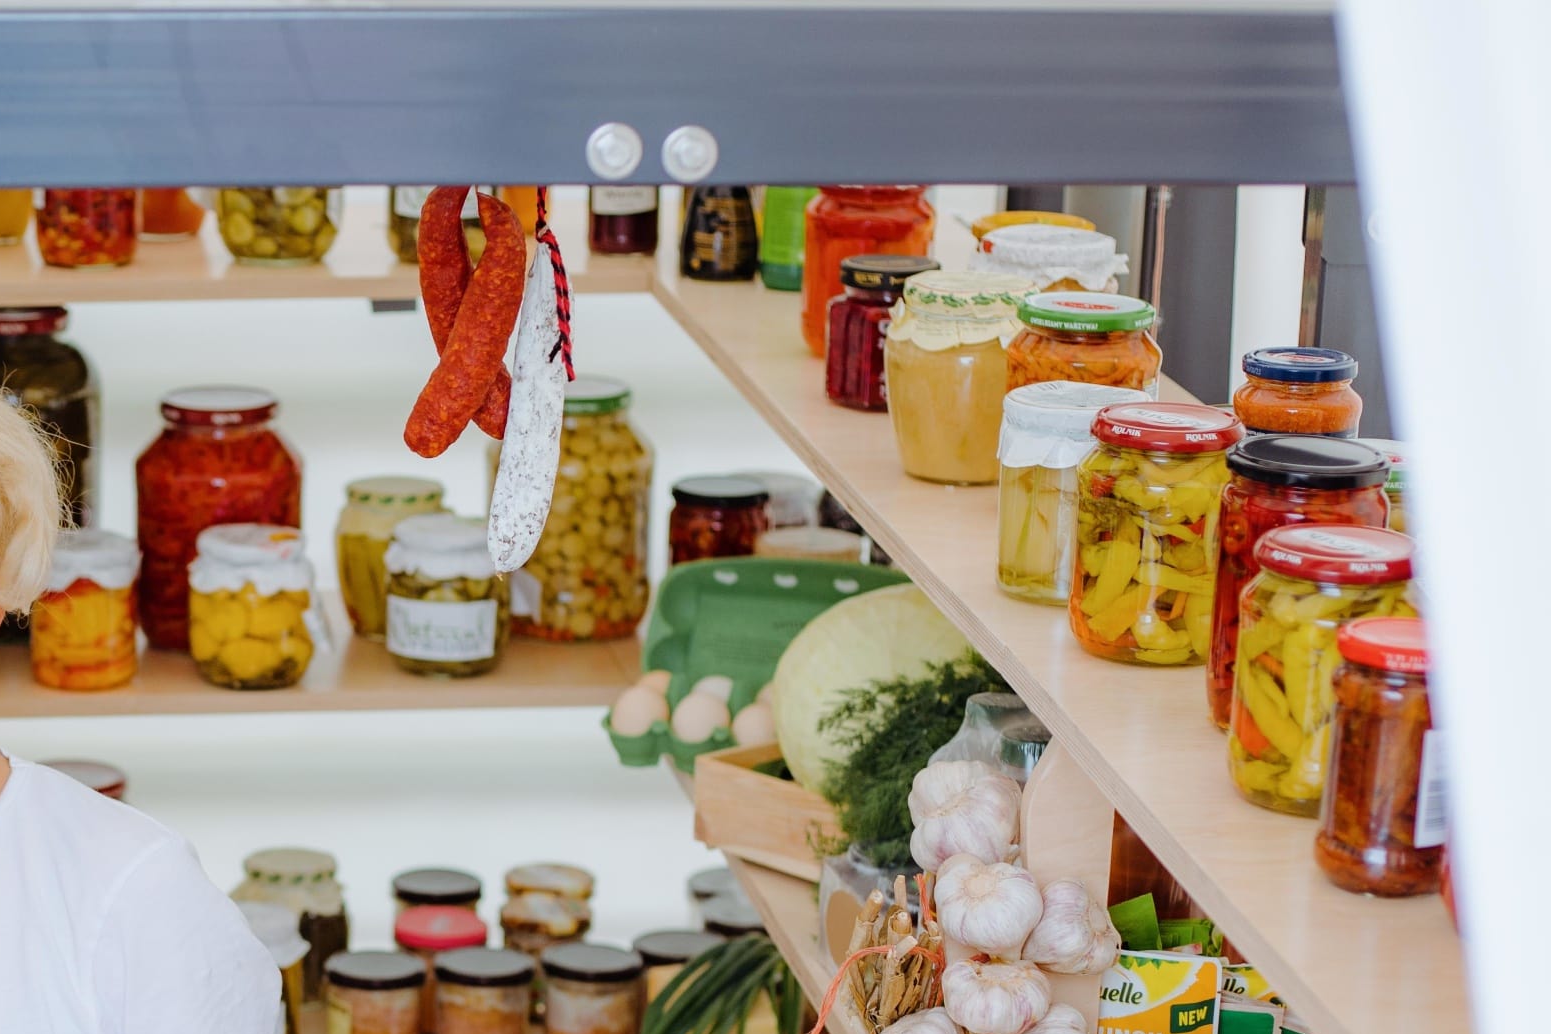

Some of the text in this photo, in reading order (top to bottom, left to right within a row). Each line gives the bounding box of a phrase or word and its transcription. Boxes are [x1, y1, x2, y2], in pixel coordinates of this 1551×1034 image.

[1111, 424, 1141, 437] ROLNIK
[1185, 433, 1218, 443] ROLNIK
[1271, 550, 1303, 565] ROLNIK
[1349, 562, 1388, 573] ROLNIK
[1100, 982, 1144, 1005] uelle
[1178, 1005, 1209, 1027] NEW
